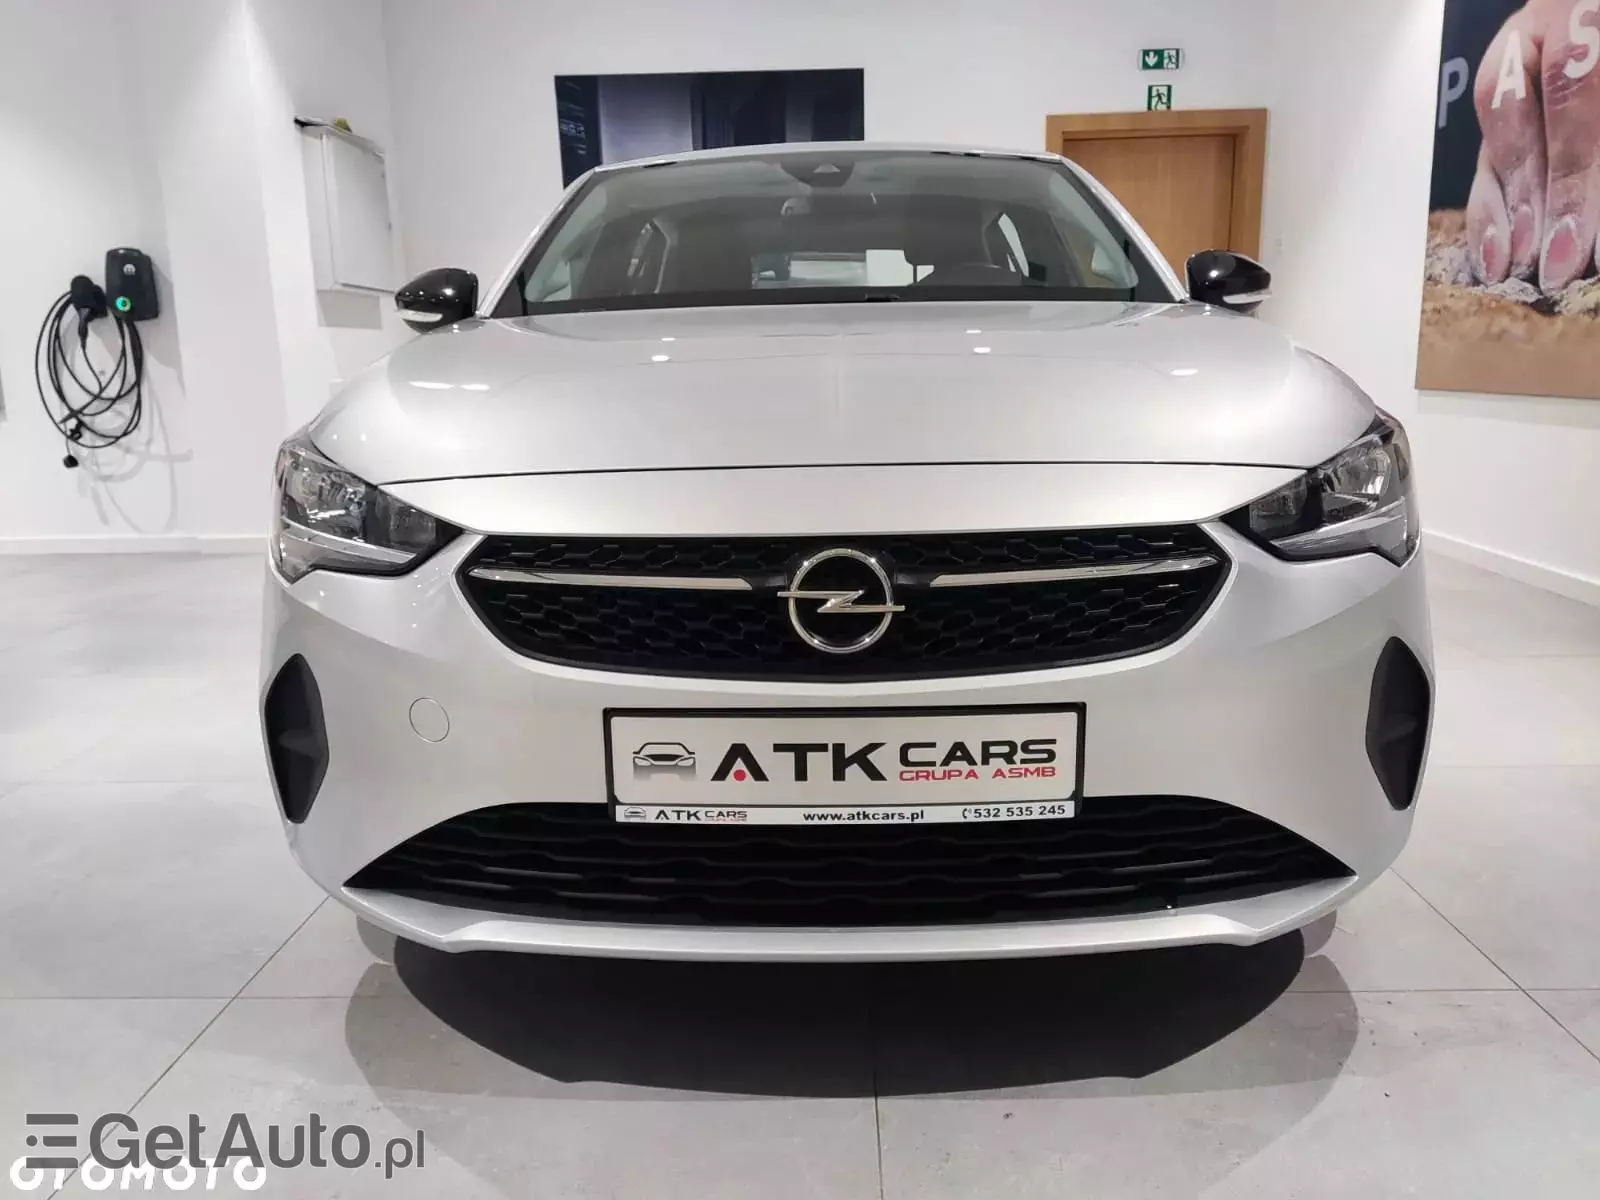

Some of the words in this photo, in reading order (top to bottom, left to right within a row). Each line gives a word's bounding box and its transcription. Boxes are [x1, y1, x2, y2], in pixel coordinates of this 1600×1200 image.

[710, 742, 887, 782] ATK
[899, 739, 1057, 767] CARS
[899, 768, 979, 781] GRUPA
[992, 767, 1056, 779] ASMB
[655, 809, 702, 821] ATK
[704, 810, 748, 819] CARS
[803, 809, 924, 822] www.atkcars.pl
[973, 808, 1001, 819] 532
[1006, 806, 1033, 817] 535
[1039, 804, 1066, 816] 245
